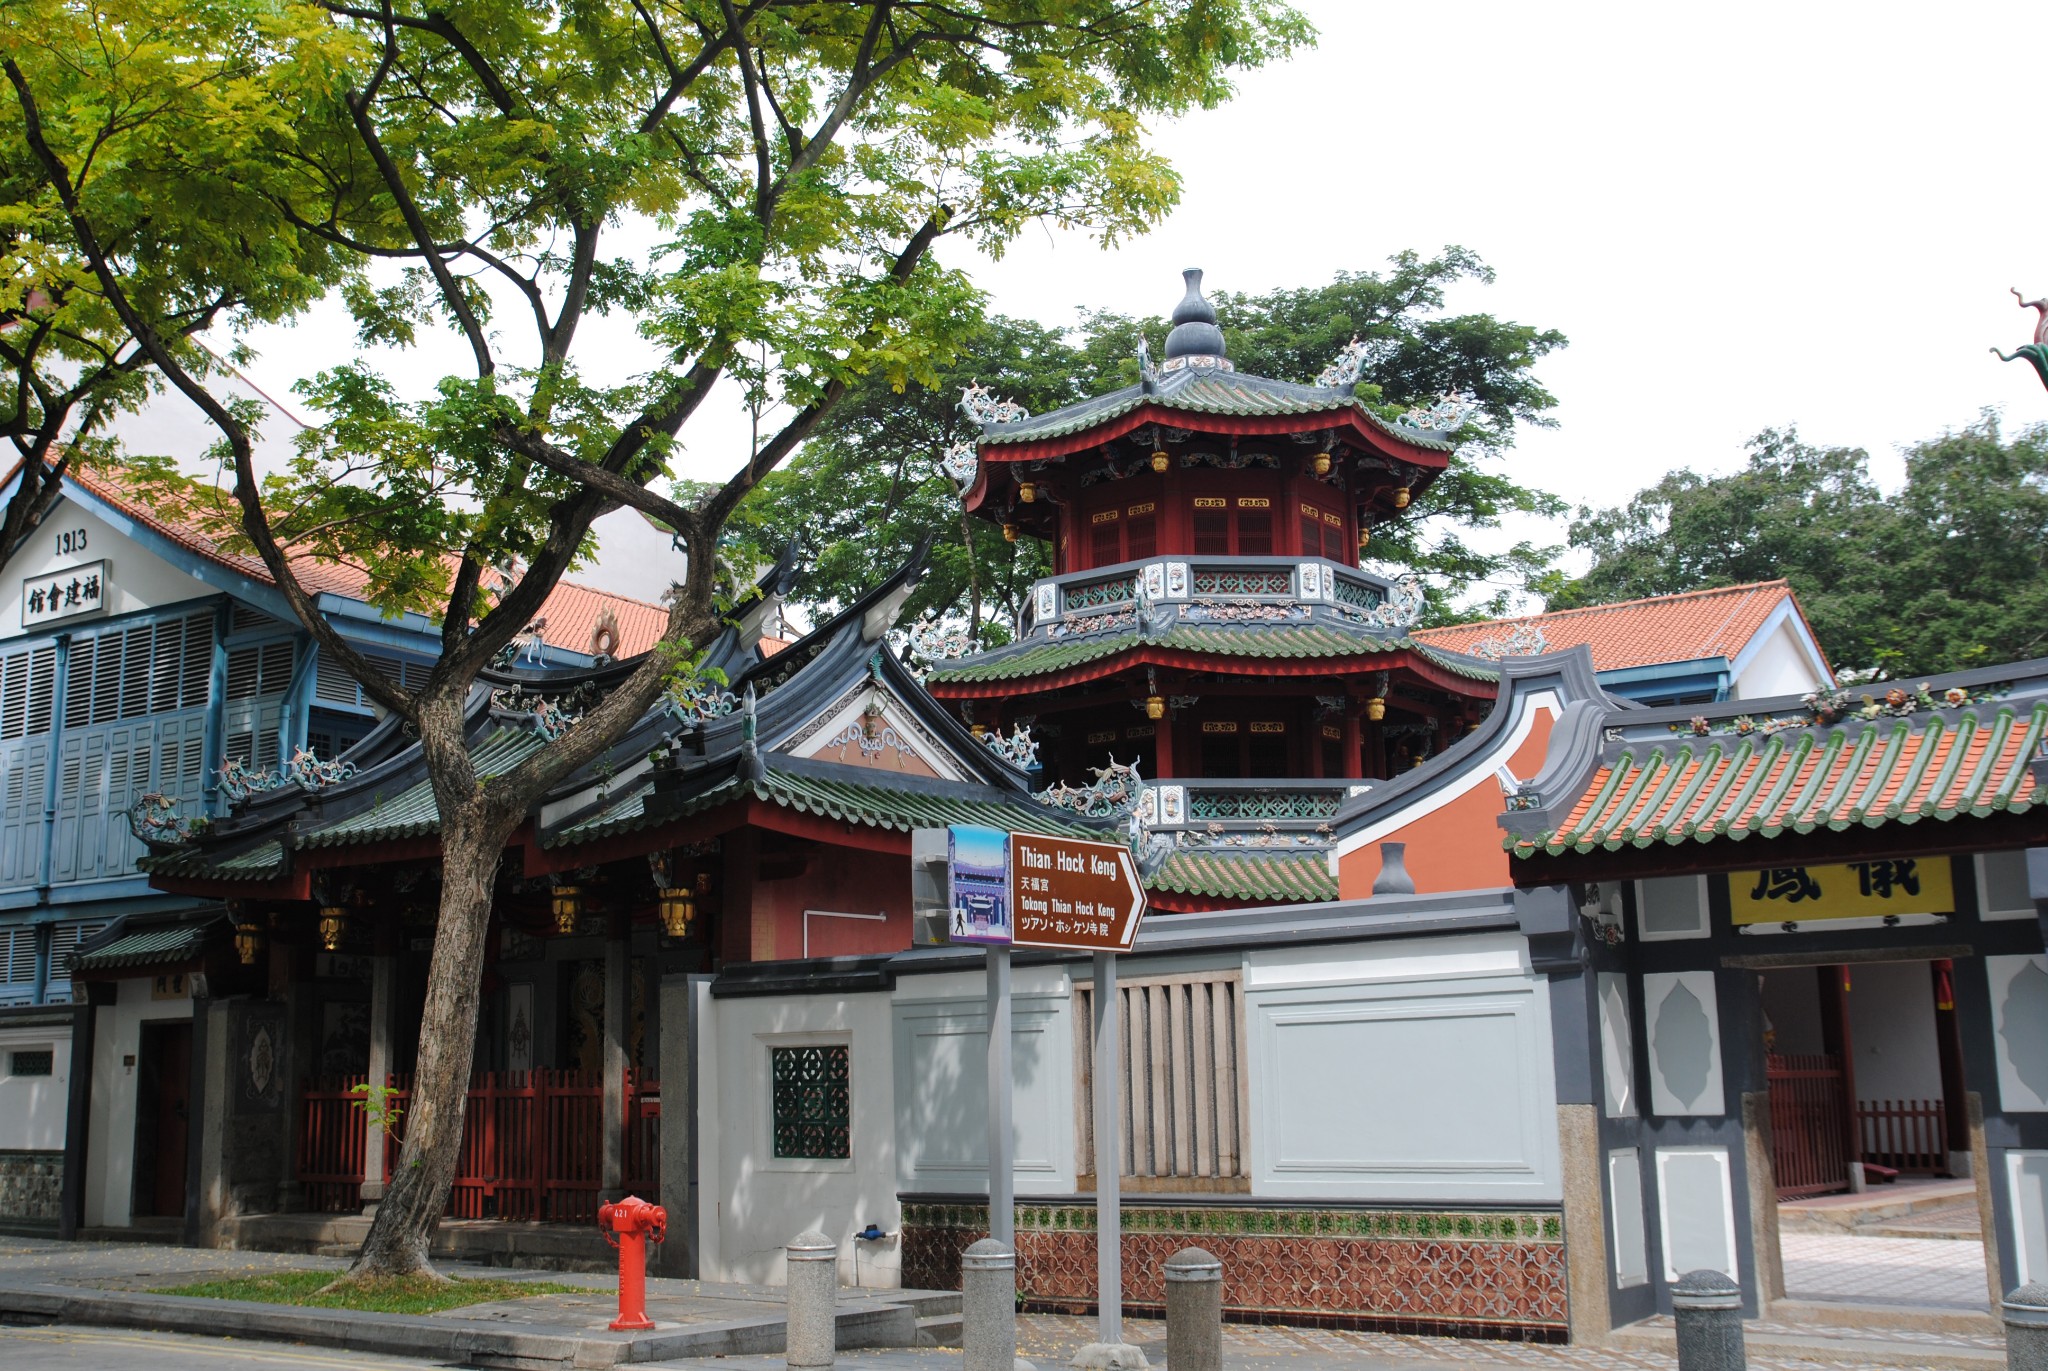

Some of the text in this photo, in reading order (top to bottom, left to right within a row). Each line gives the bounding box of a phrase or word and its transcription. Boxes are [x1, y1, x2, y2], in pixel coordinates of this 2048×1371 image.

[55, 528, 87, 555] 1913
[1020, 846, 1116, 881] Thian Hock Keng
[1021, 876, 1049, 892] 天福宮
[1021, 895, 1115, 921] Tokong Thian Hock Keng
